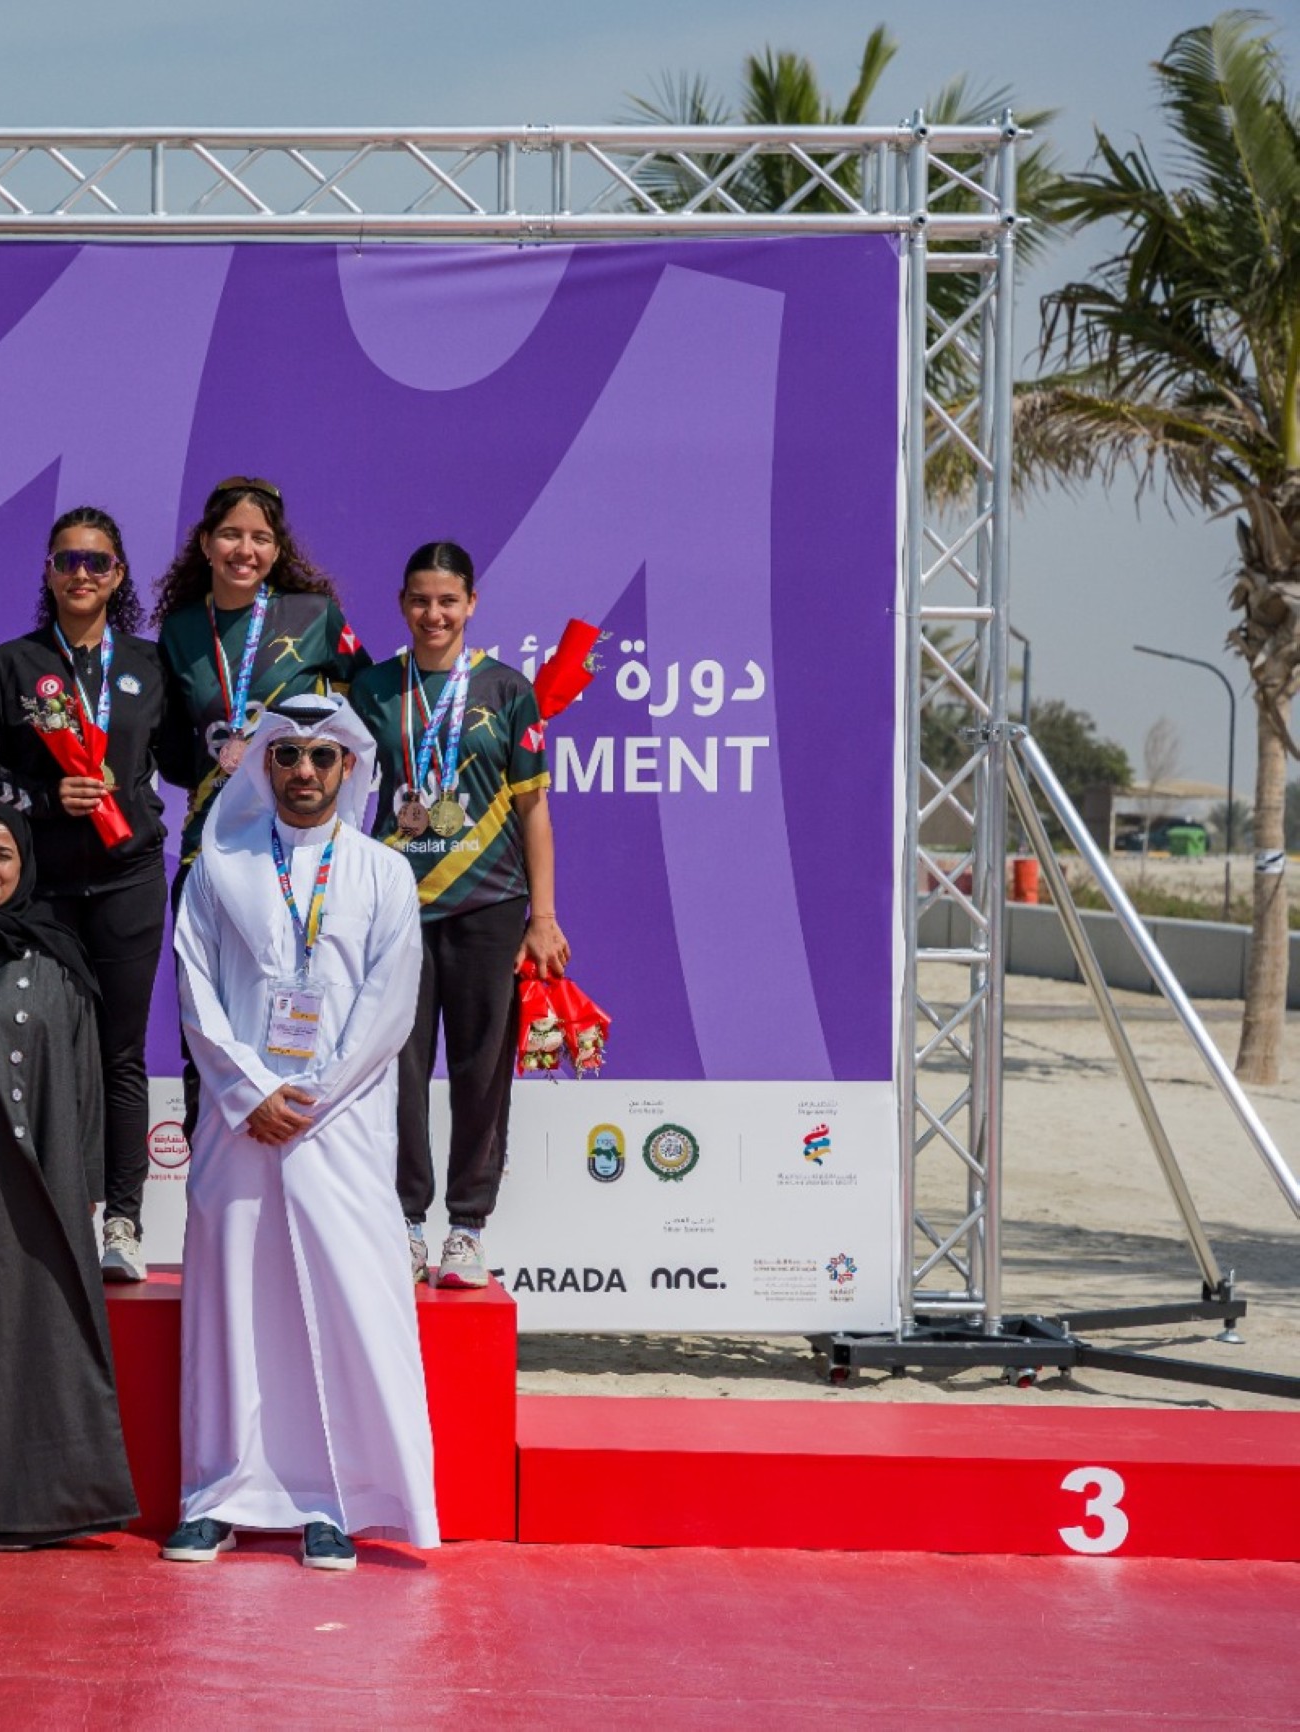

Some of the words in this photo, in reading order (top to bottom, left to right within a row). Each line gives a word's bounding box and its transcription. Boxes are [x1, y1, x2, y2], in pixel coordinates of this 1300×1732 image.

[615, 639, 766, 717] دورة
[554, 736, 770, 793] MENT
[512, 1267, 627, 1293] ARADA
[1058, 1466, 1130, 1555] 3
